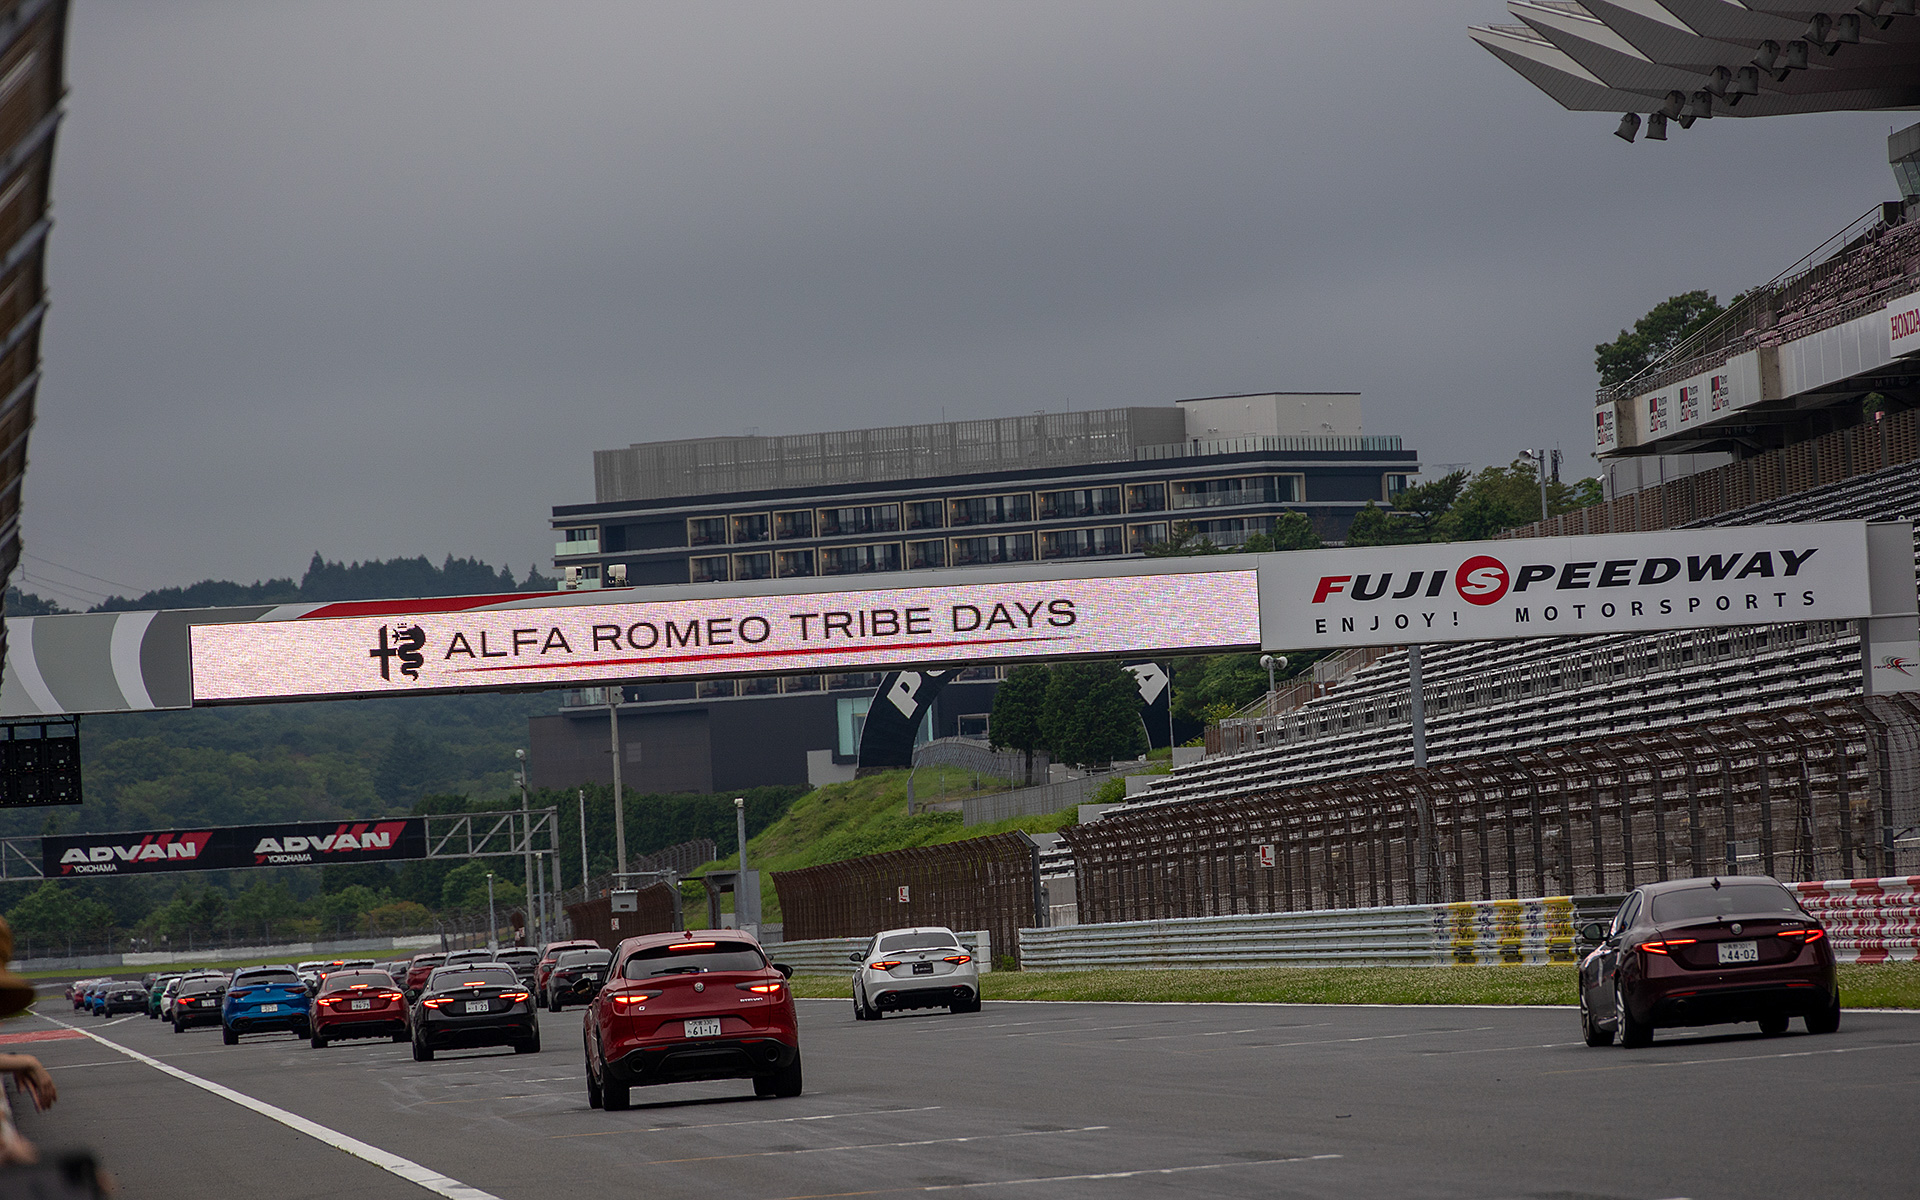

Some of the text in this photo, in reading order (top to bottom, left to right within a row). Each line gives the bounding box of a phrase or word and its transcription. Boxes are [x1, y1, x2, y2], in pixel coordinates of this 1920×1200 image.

[1891, 308, 1920, 340] HONDA
[1312, 549, 1818, 604] FUJI SPEEDWAY
[1315, 590, 1816, 634] ENJOY! MOTORSPORTS
[444, 599, 1077, 660] ALFA ROMEO TRIBE DAYS
[60, 842, 196, 863] ADVAN
[253, 832, 390, 854] ADVAN
[73, 863, 118, 873] YOKOHAMA
[267, 853, 312, 863] YOKOHAMA
[1728, 949, 1756, 960] 44-02
[693, 1025, 719, 1036] 61-17
